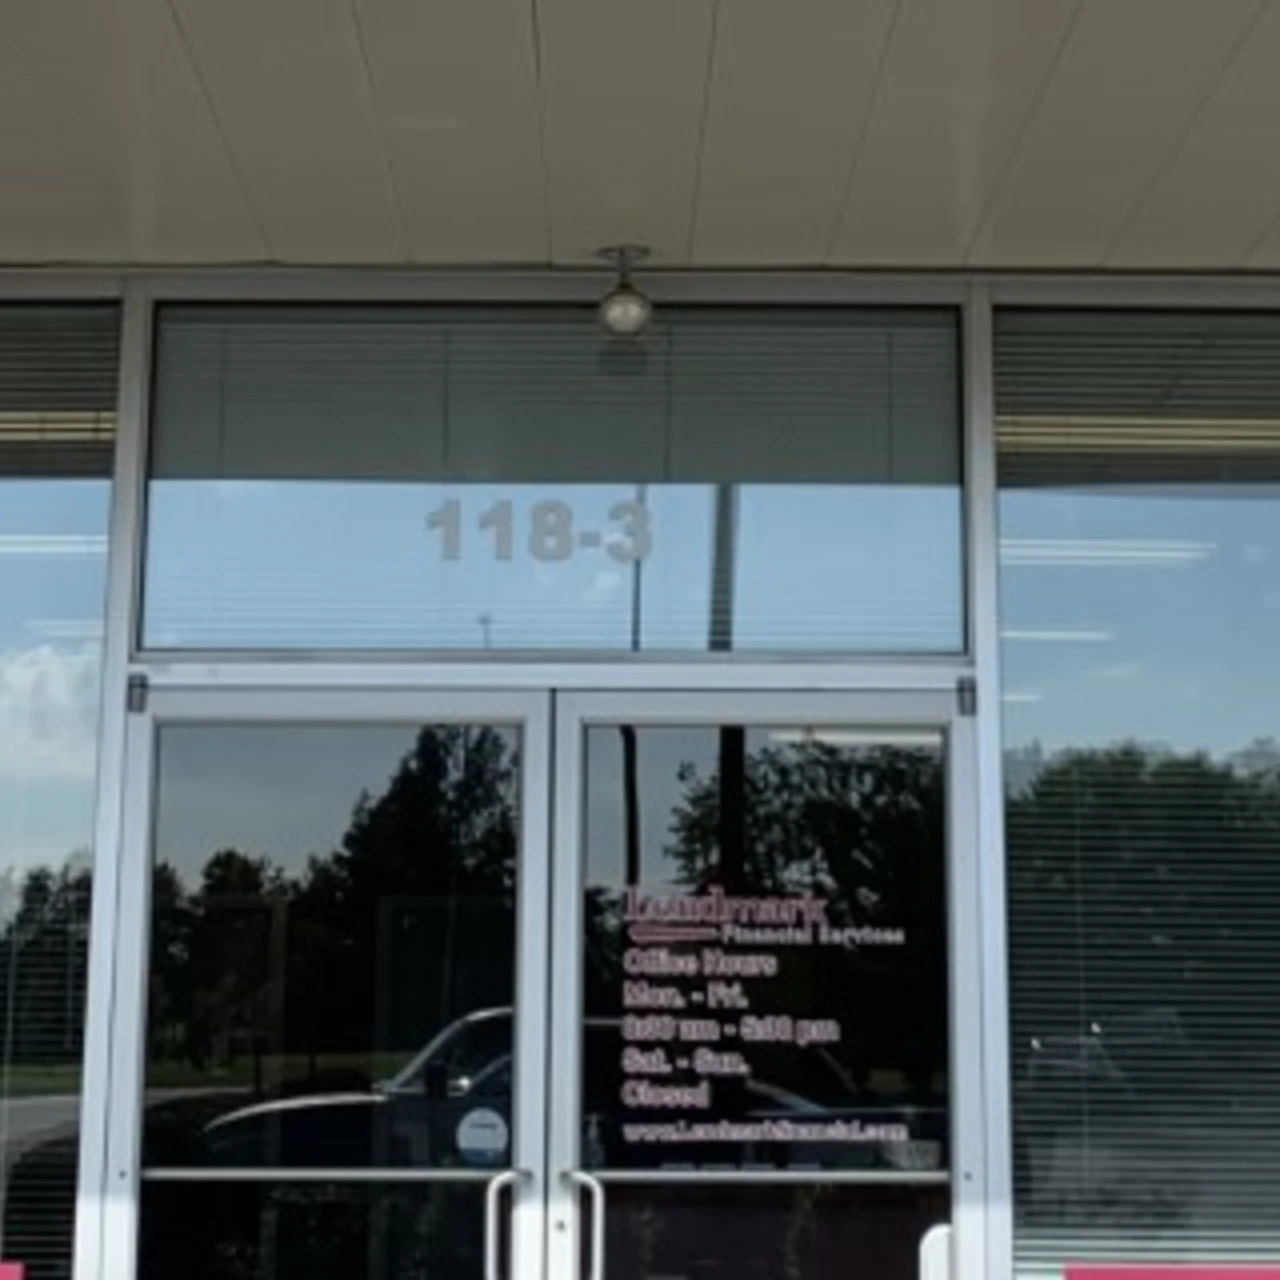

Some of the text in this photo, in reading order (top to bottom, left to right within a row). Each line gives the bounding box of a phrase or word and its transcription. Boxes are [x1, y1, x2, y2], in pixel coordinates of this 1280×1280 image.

[424, 498, 653, 564] 118-3
[624, 885, 828, 924] Lendmark
[721, 923, 906, 946] Financial Services
[623, 949, 778, 976] Office Hours
[678, 1019, 721, 1041] am
[795, 1019, 841, 1047] pm
[622, 1080, 710, 1109] Closed
